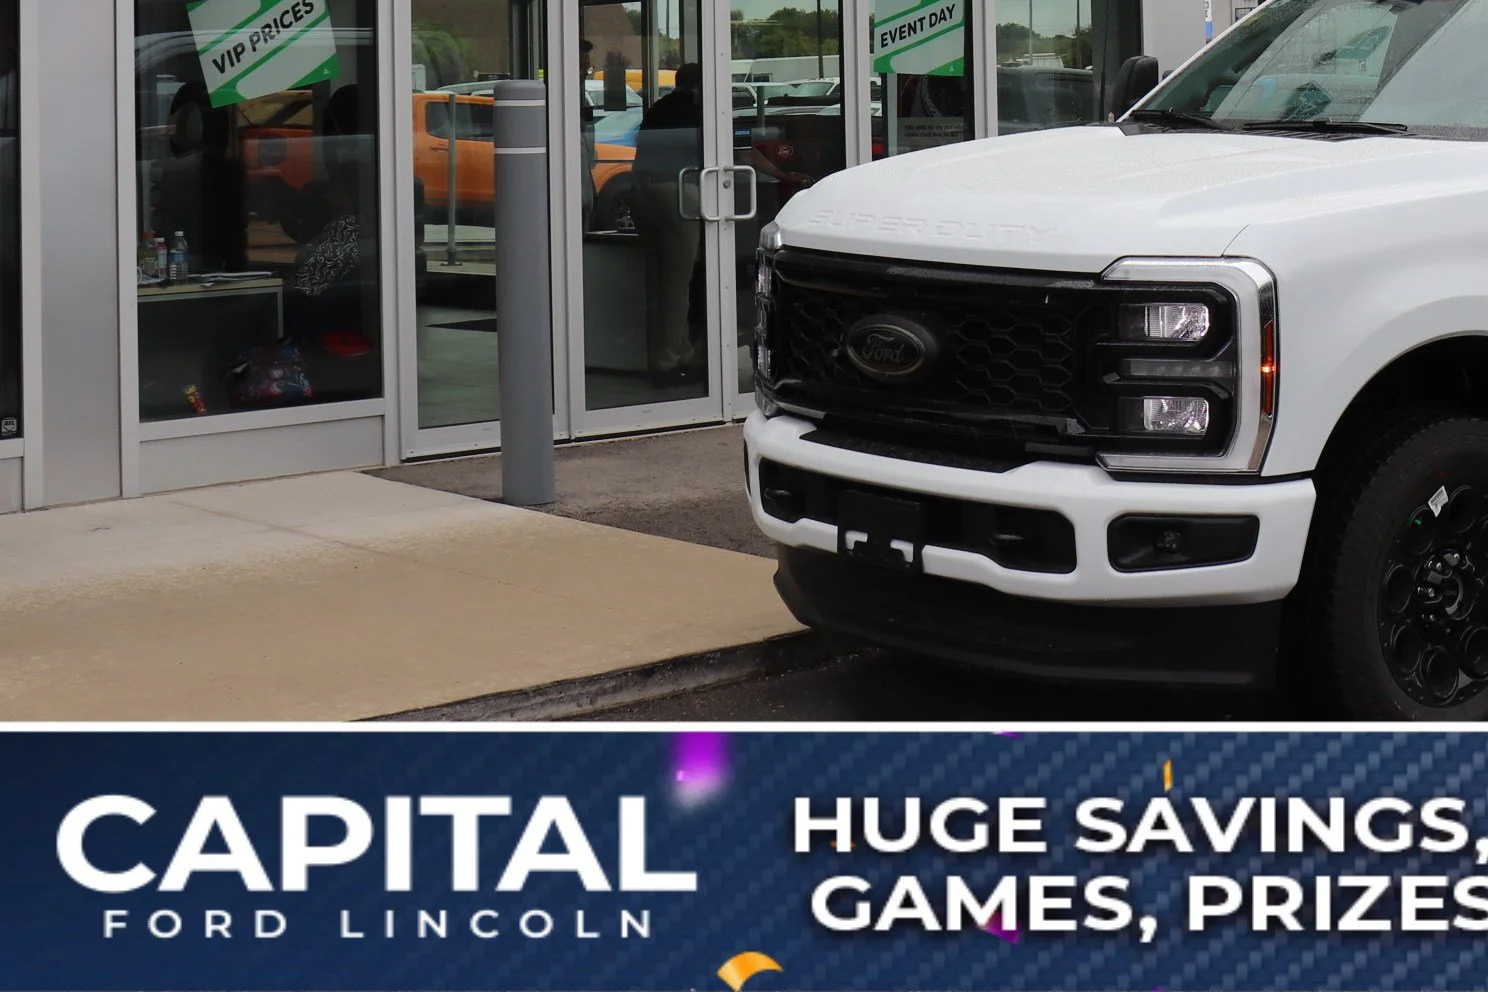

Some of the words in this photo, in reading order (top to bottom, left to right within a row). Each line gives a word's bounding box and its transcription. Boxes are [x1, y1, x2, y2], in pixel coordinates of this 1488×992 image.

[880, 16, 926, 49] EVENT
[929, 3, 956, 29] DAY
[212, 42, 246, 74] VIP
[808, 209, 928, 235] SUPER
[933, 219, 1058, 244] DUTY
[862, 333, 905, 364] Ford
